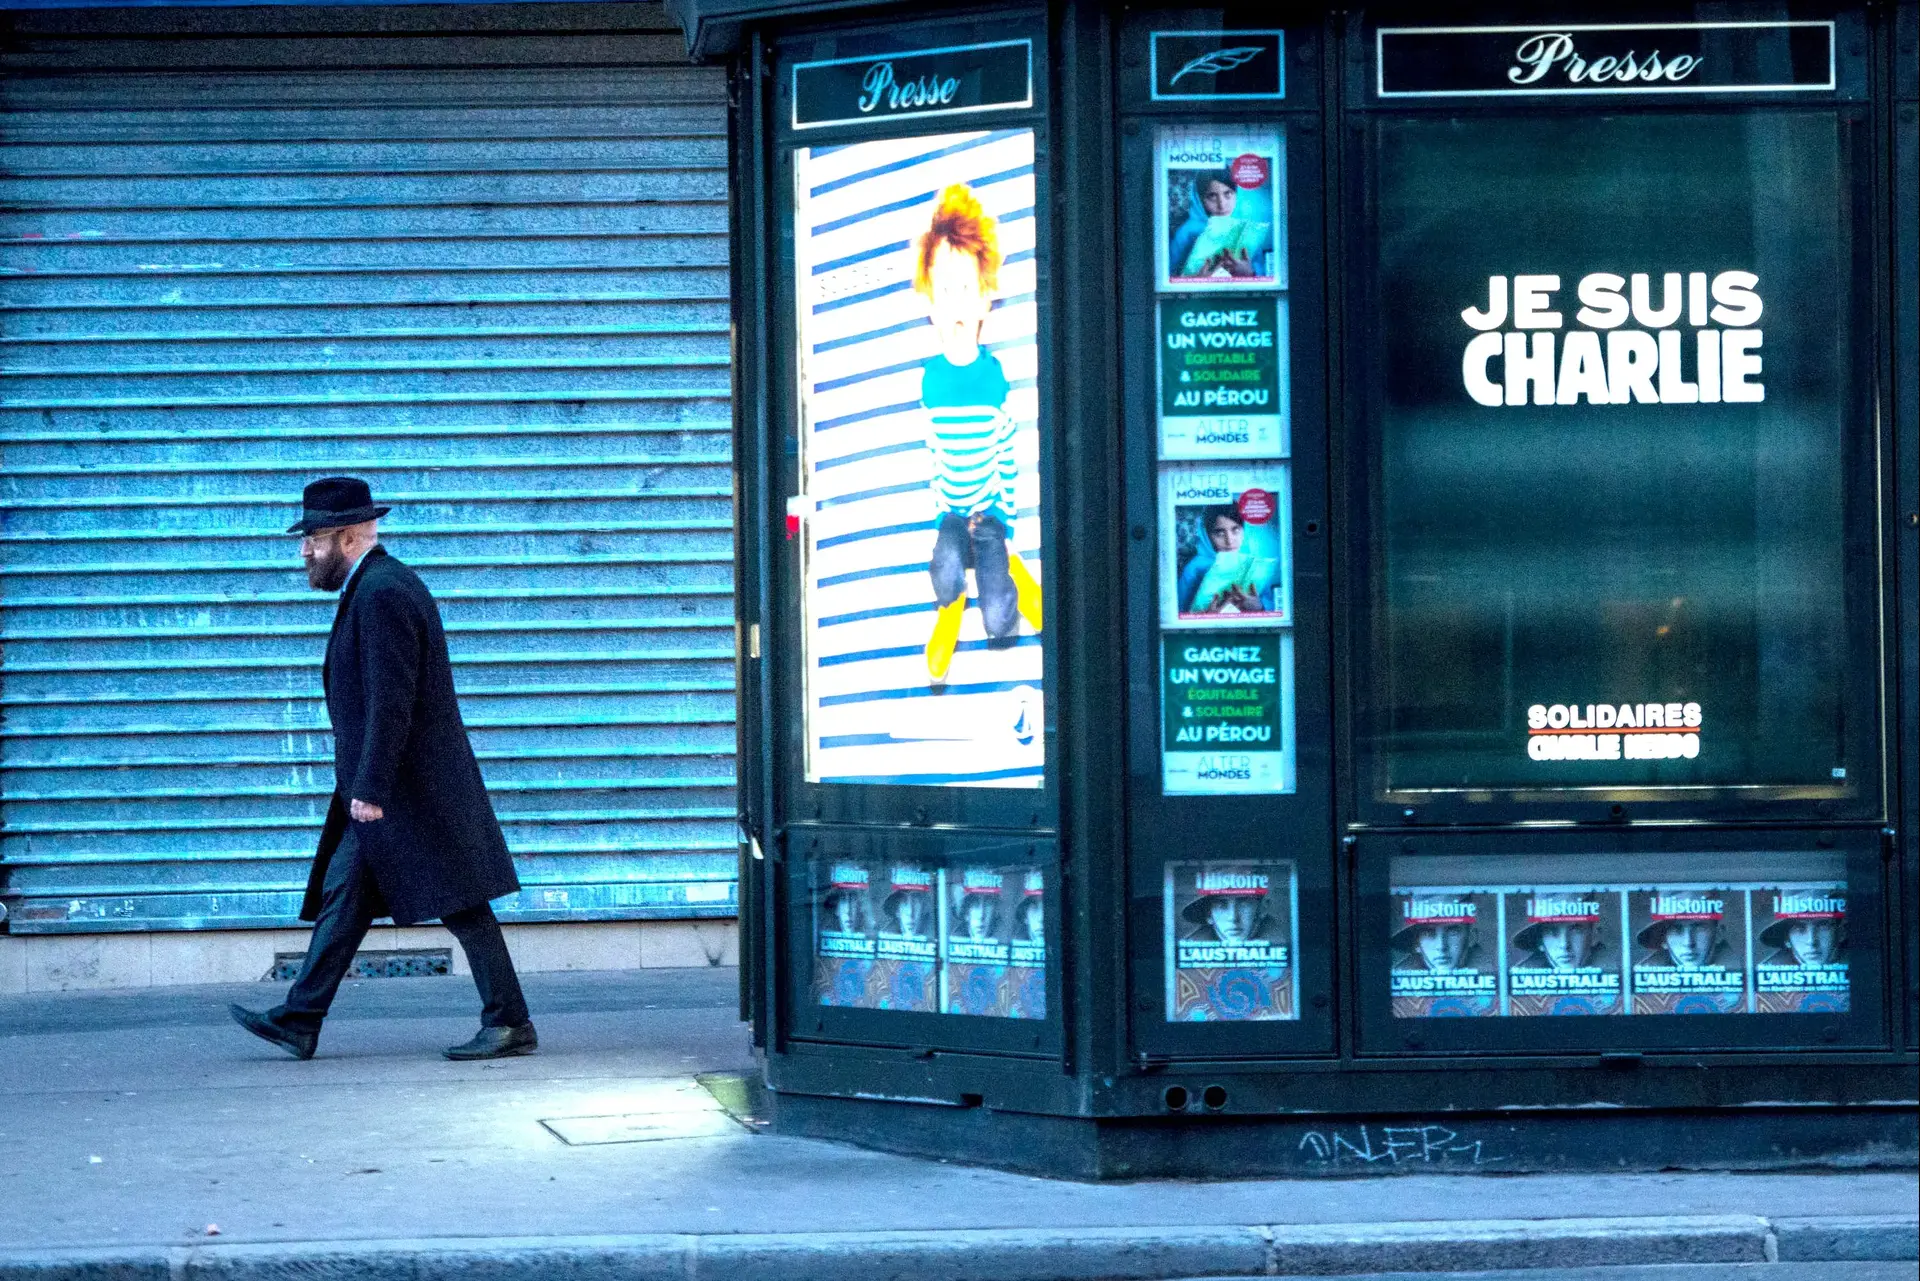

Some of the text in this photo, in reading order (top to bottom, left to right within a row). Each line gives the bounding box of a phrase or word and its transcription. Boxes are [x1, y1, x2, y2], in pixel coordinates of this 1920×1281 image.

[1507, 33, 1703, 84] Presse
[859, 61, 962, 113] Presse
[1169, 153, 1223, 163] MONDES
[1461, 271, 1764, 331] JE SUIS
[1180, 310, 1259, 327] GAGNEZ
[1167, 331, 1273, 348] UN VOYAGE
[1462, 330, 1764, 406] CHARLIE
[1180, 370, 1261, 382] & SOLIDAIRE
[1174, 386, 1269, 406] AU PÉROU
[1196, 433, 1249, 443] MONDES
[1176, 488, 1230, 499] MONDES
[1183, 647, 1261, 662] GAGNEZ
[1170, 668, 1275, 684] UN VOYAGE
[1182, 706, 1264, 718] & SOLIDAIRE
[1528, 702, 1702, 729] SOLIDAIRES
[1176, 721, 1271, 742] AU PÉROU
[1198, 769, 1251, 780] MONDES
[1179, 947, 1288, 961] L'AUSTRALIE
[1391, 976, 1496, 989] L'AUSTRALIE
[1511, 974, 1620, 988] L'AUSTRALIE
[1634, 972, 1743, 986] L'AUSTRALIE
